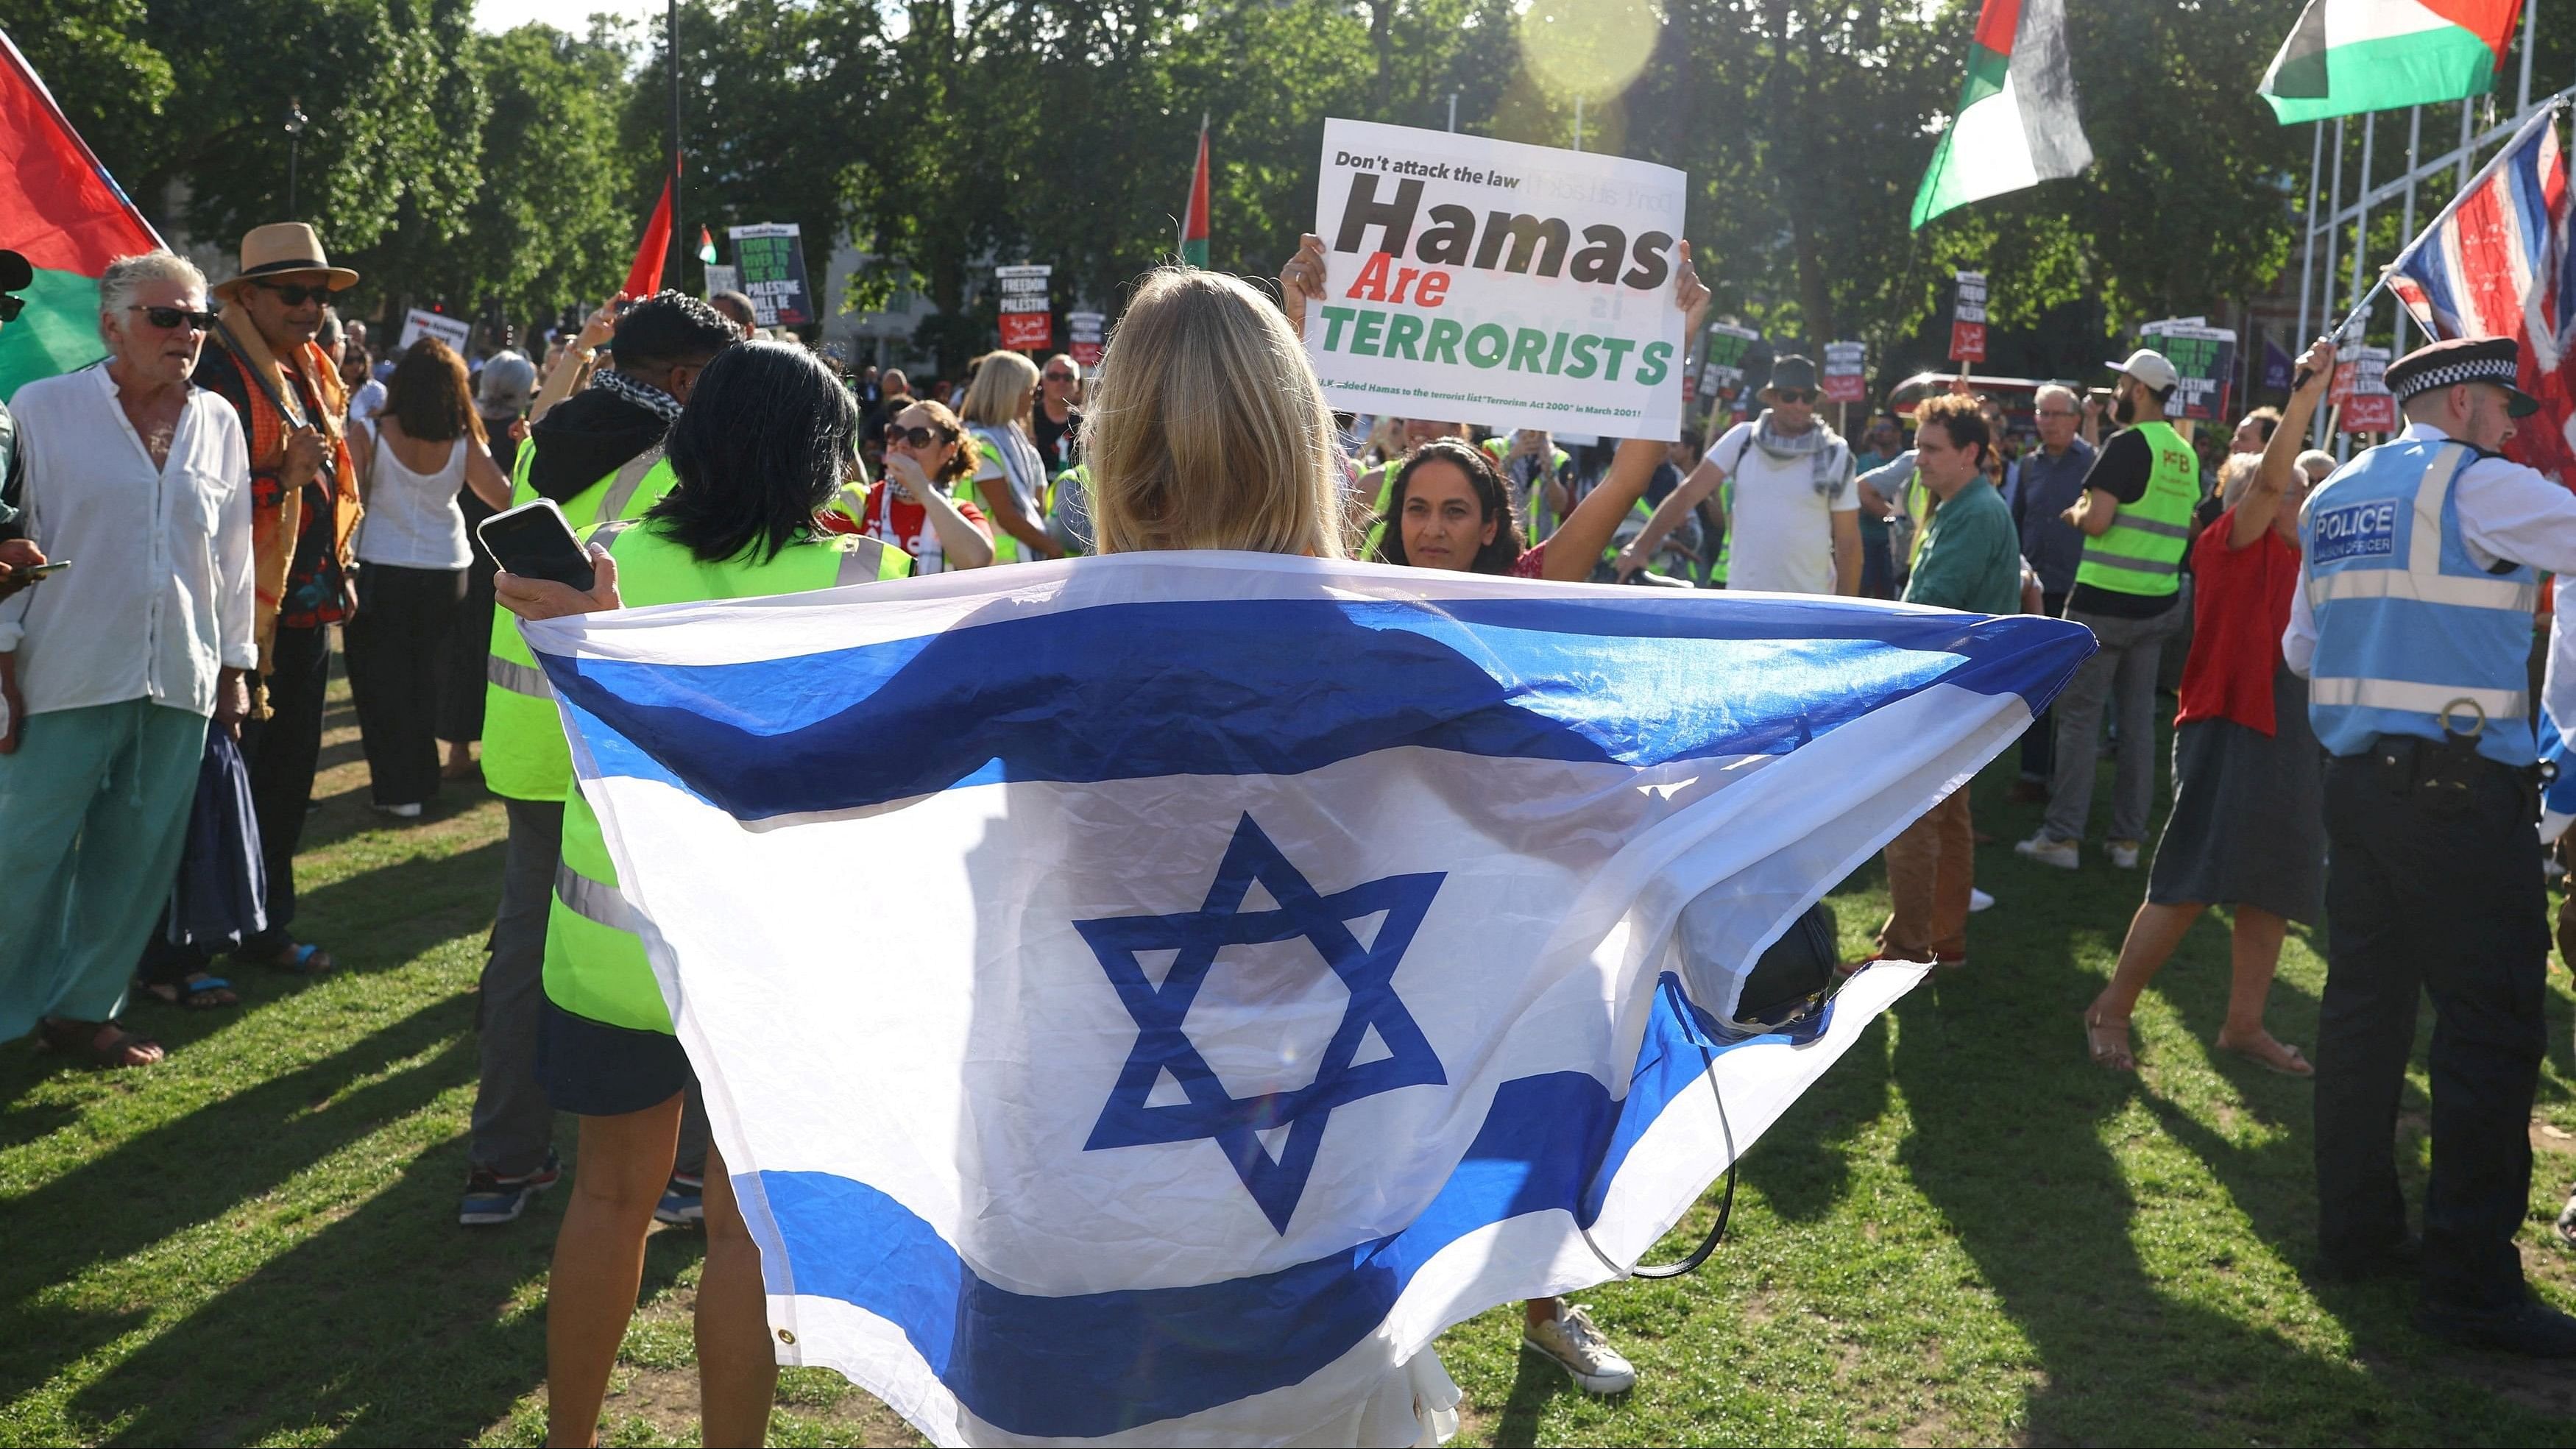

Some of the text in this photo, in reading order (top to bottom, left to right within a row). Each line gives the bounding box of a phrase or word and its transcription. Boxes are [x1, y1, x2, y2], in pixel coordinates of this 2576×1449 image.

[1334, 151, 1390, 171] Don't
[1392, 160, 1451, 180] attack
[1453, 166, 1483, 185] the
[1487, 170, 1521, 189] law
[1334, 171, 1674, 291] Hamas
[745, 279, 802, 297] PALESTINE
[1001, 277, 1048, 293] FREEDOM
[1345, 251, 1451, 308] Are
[756, 309, 779, 326] REE
[999, 297, 1050, 313] PALESTINE
[1319, 305, 1674, 387] TERRORISTS
[1336, 380, 1367, 392] added
[1368, 384, 1401, 395] Hamas
[1402, 386, 1412, 396] to
[1412, 388, 1429, 398] the
[1431, 391, 1466, 402] terrorist
[1529, 400, 1544, 410] Act
[1576, 405, 1584, 414] in
[1584, 405, 1612, 416] March
[1613, 408, 1642, 418] 2001!
[2315, 506, 2393, 542] POLICE
